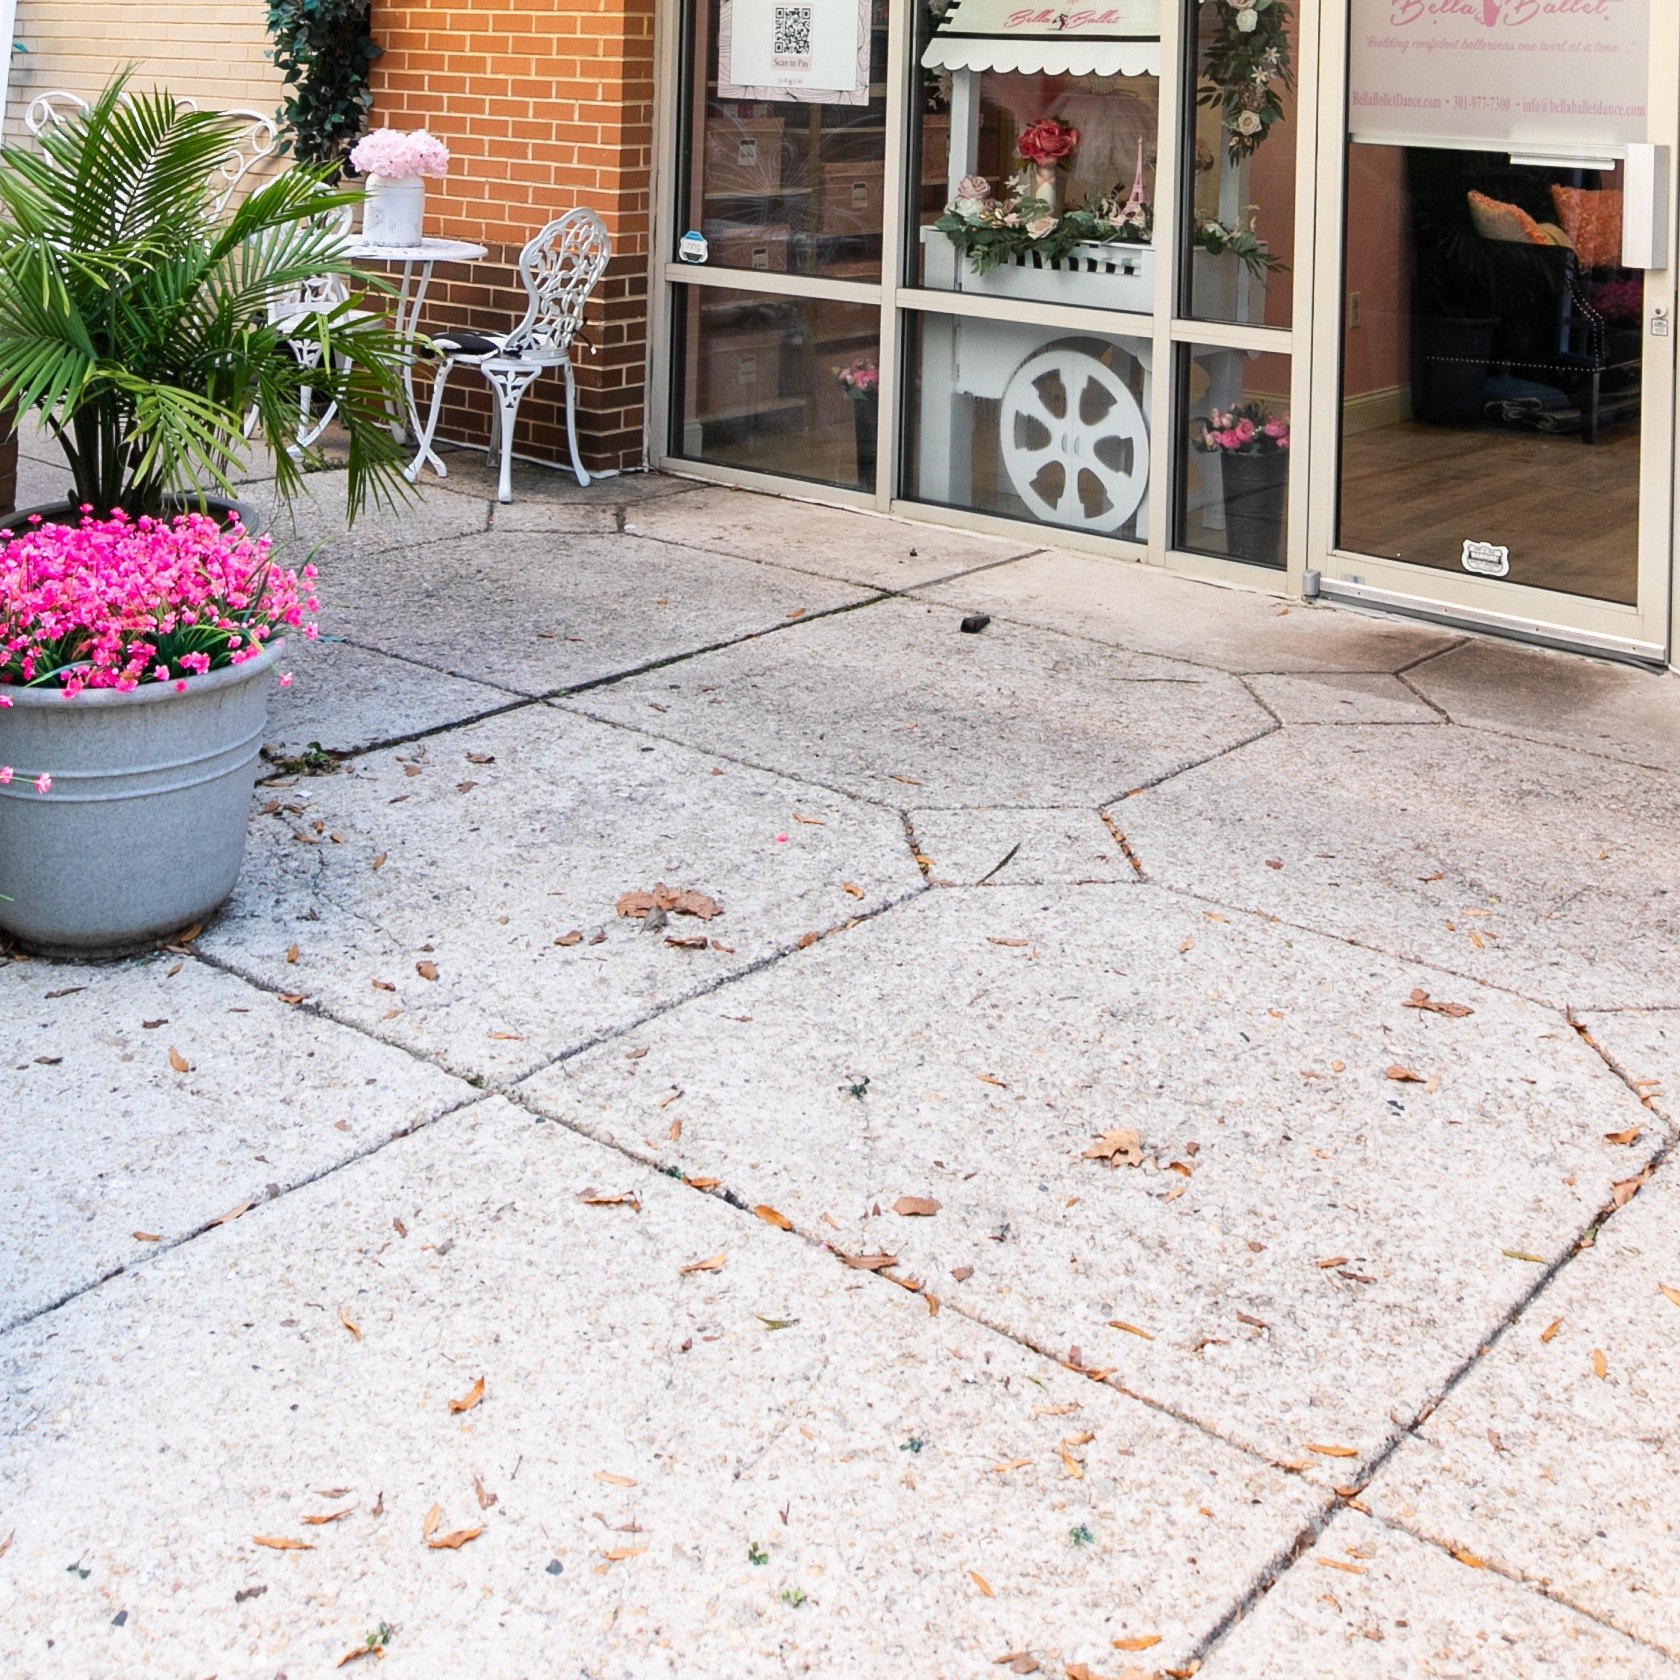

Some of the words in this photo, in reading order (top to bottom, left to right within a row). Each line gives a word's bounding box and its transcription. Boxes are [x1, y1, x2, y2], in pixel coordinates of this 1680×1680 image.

[1004, 9, 1055, 29] Bella
[1066, 9, 1126, 29] Ballet
[1412, 38, 1459, 54] confident
[1517, 42, 1537, 52] one
[1569, 39, 1583, 52] at
[1583, 44, 1592, 52] a
[774, 58, 789, 67] Scan
[798, 59, 808, 69] Pay
[1352, 91, 1442, 109] BellaBalletDance.com
[1453, 95, 1511, 112] 301-977-7300
[1522, 98, 1646, 118] info@bellaballetdance.com
